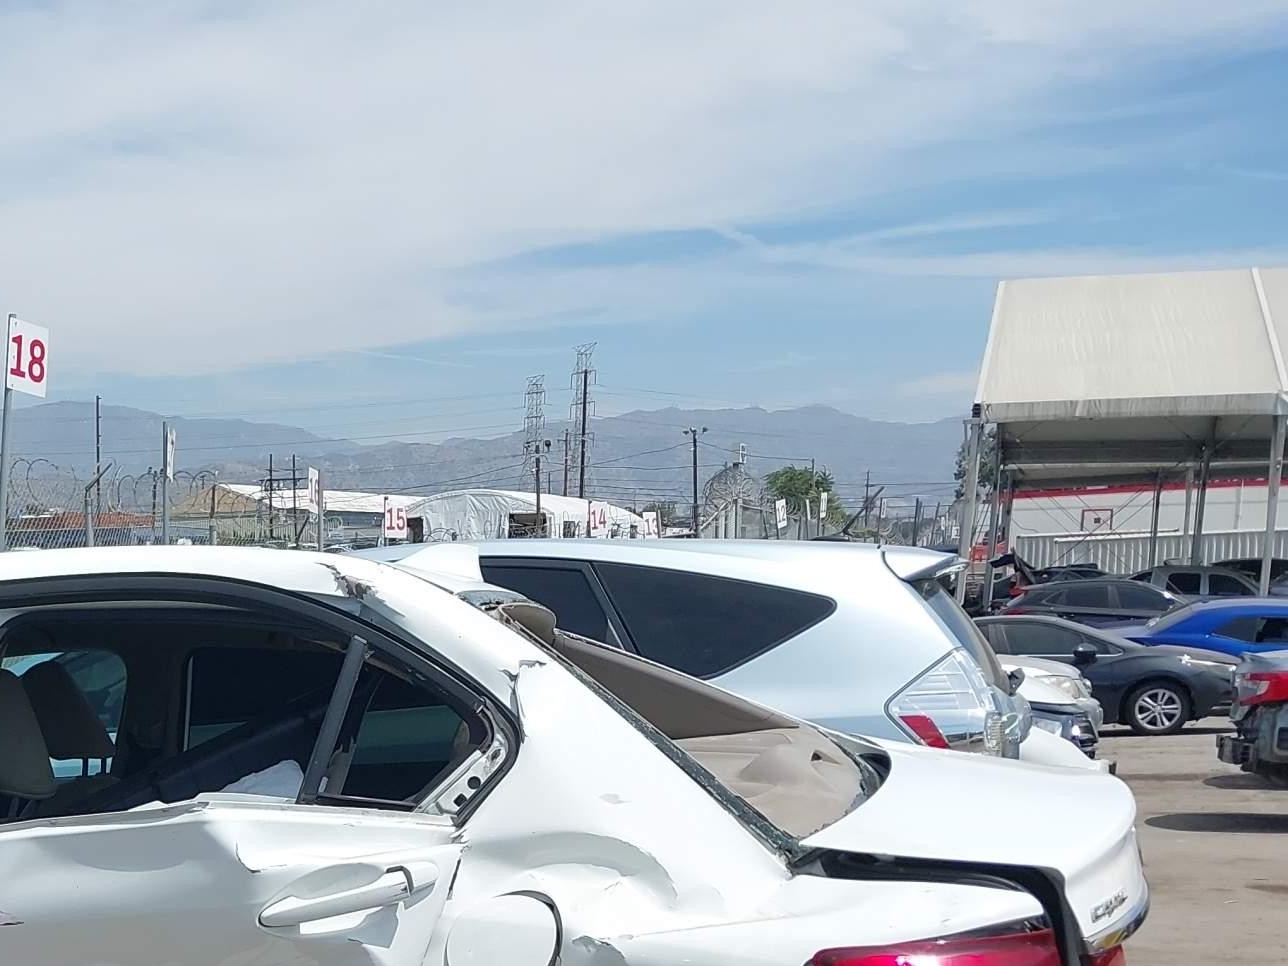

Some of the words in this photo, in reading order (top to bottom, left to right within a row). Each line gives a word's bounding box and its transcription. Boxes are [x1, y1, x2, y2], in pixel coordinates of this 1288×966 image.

[10, 335, 45, 383] 18
[386, 507, 406, 531] 15
[590, 508, 607, 531] 14
[777, 505, 788, 524] 12
